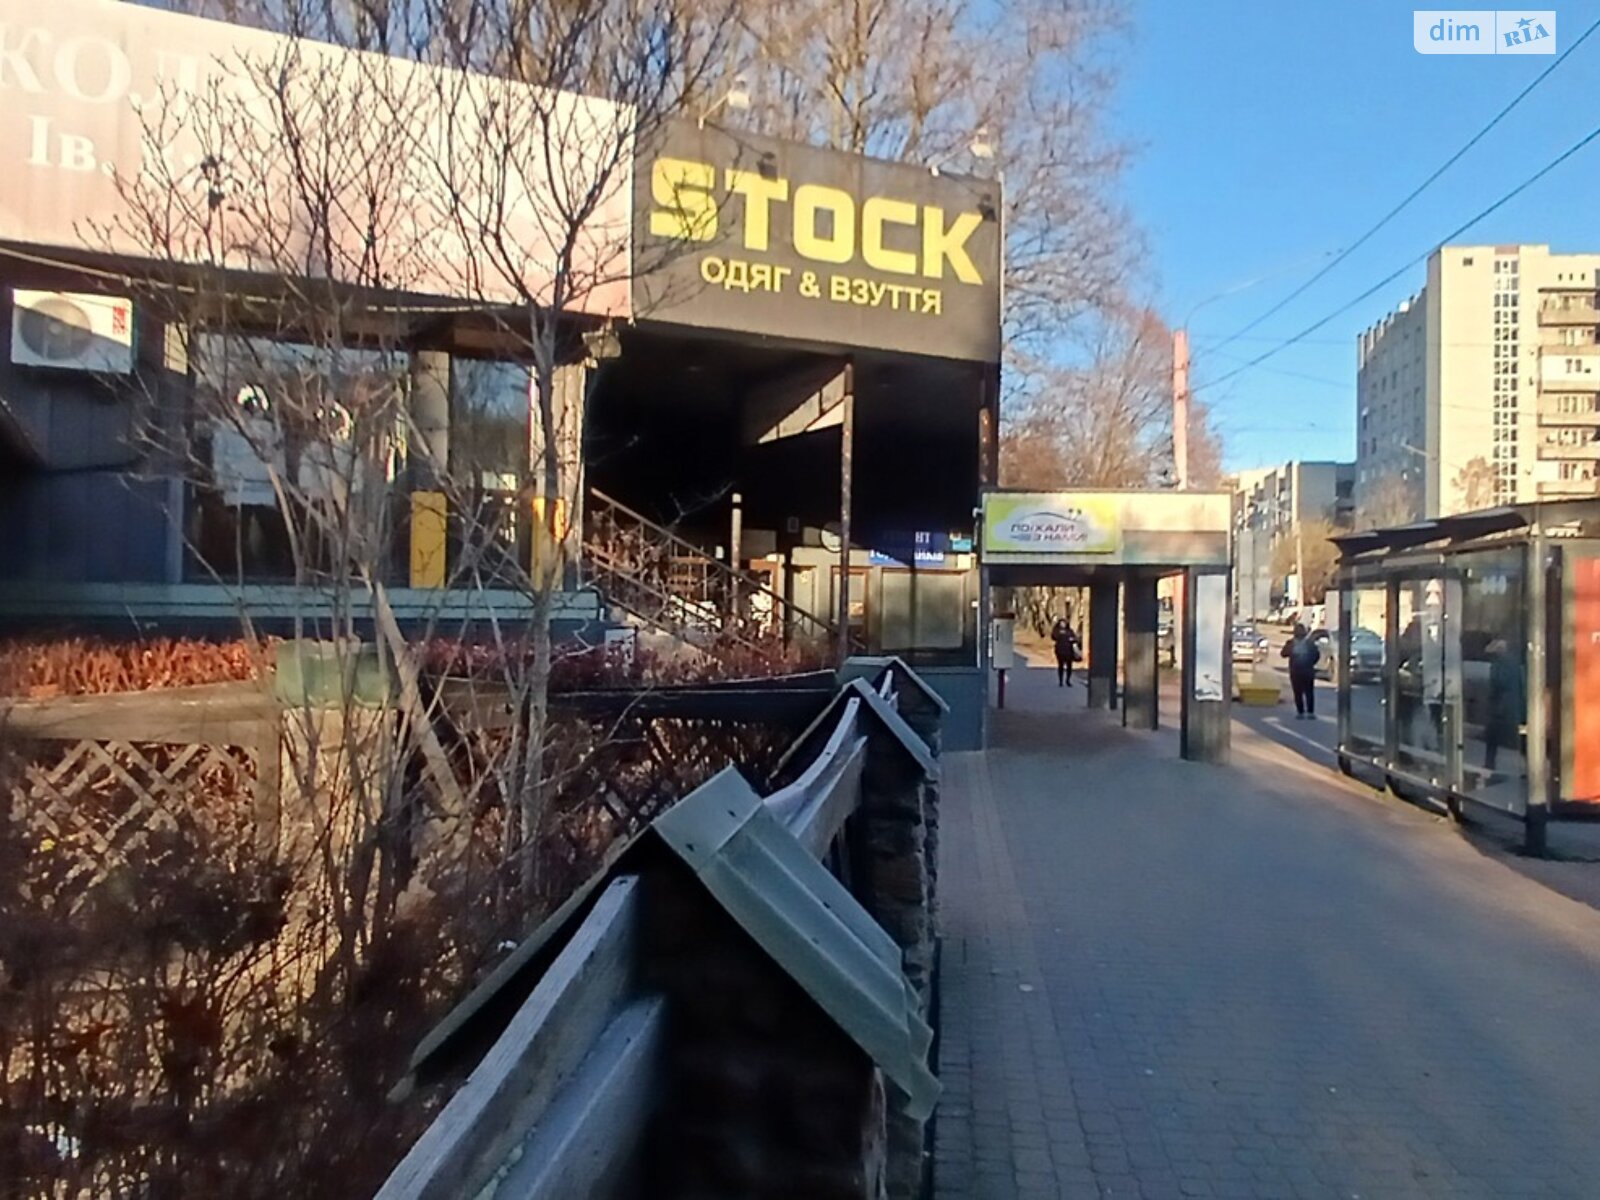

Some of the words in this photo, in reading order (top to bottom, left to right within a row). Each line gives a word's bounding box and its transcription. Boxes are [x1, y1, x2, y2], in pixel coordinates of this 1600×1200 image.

[650, 157, 984, 286] STOCK
[701, 256, 791, 293] ОДЯГ
[799, 271, 821, 298] &
[830, 275, 942, 315] ВЗУТТЯ
